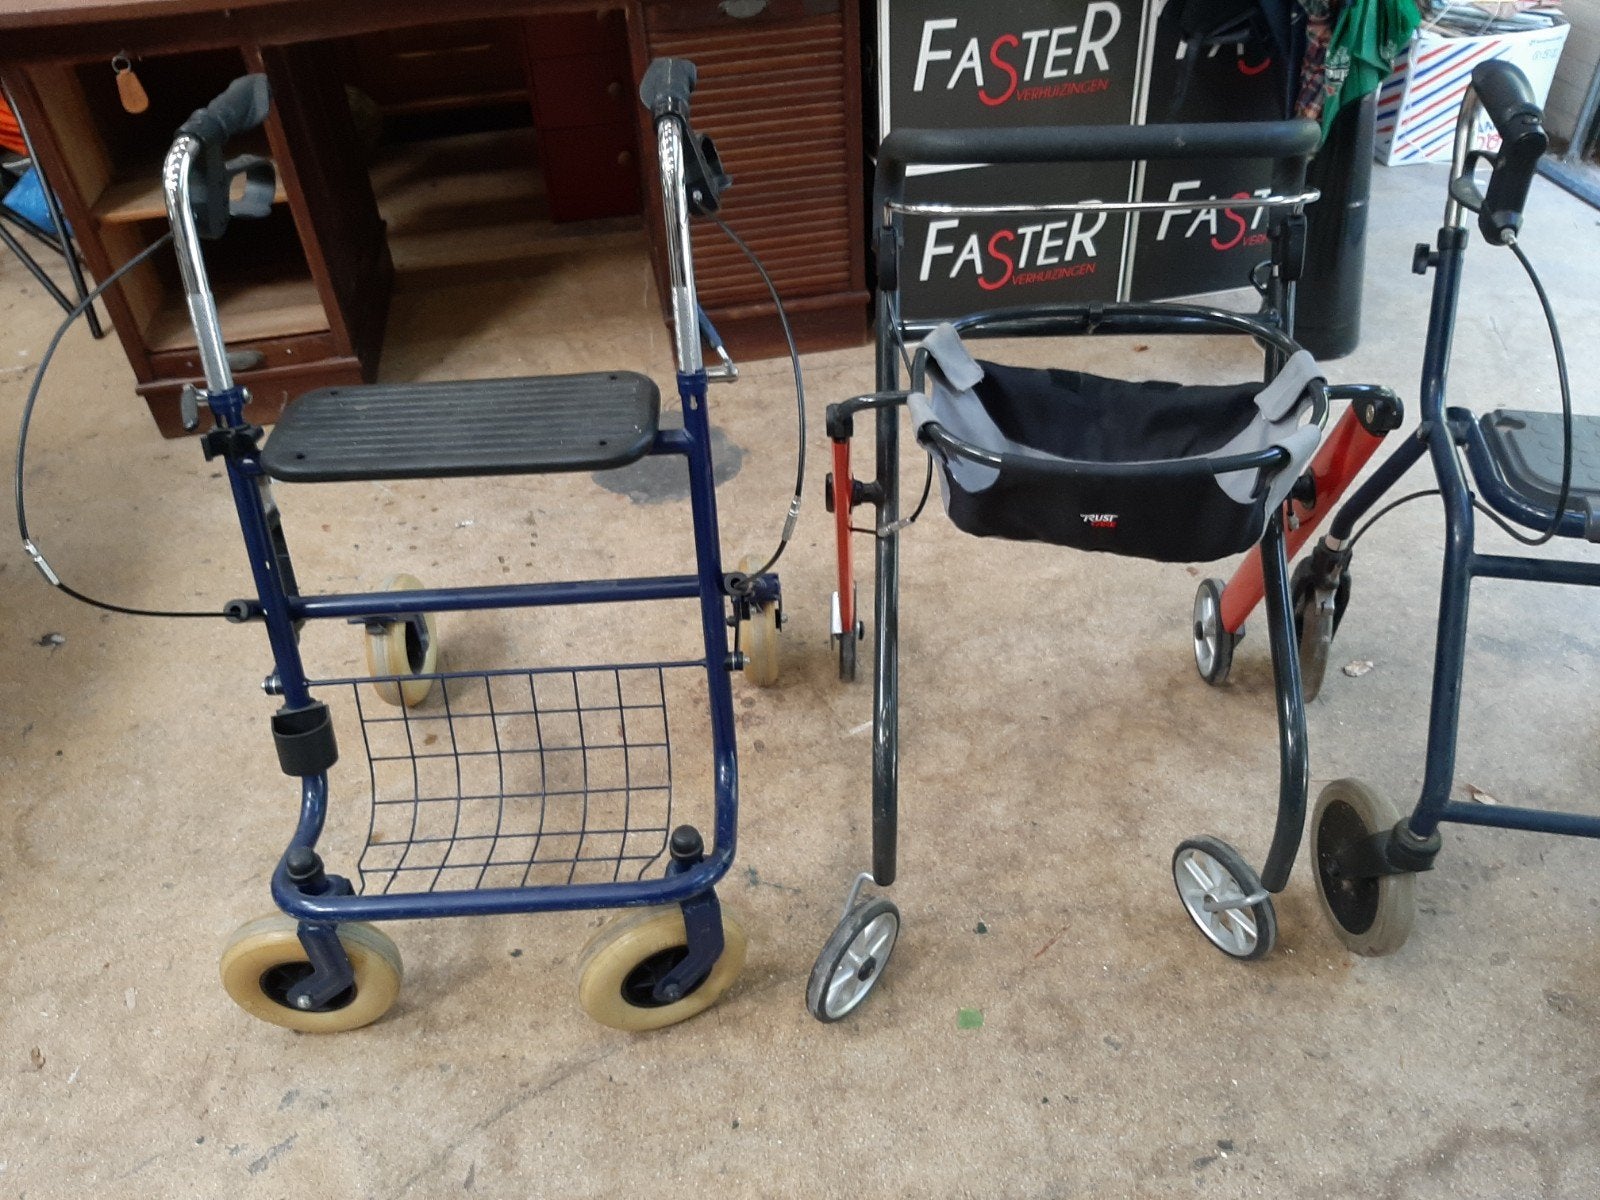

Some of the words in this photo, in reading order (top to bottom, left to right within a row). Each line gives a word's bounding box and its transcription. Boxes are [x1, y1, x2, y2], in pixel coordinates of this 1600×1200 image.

[914, 1, 1121, 105] FASTER
[1017, 79, 1110, 100] VERHUIZINGEN
[1156, 180, 1271, 250] FAST
[919, 200, 1107, 290] FASTER
[1012, 262, 1096, 285] VERHUIZINGEN
[1080, 513, 1118, 522] TRUST
